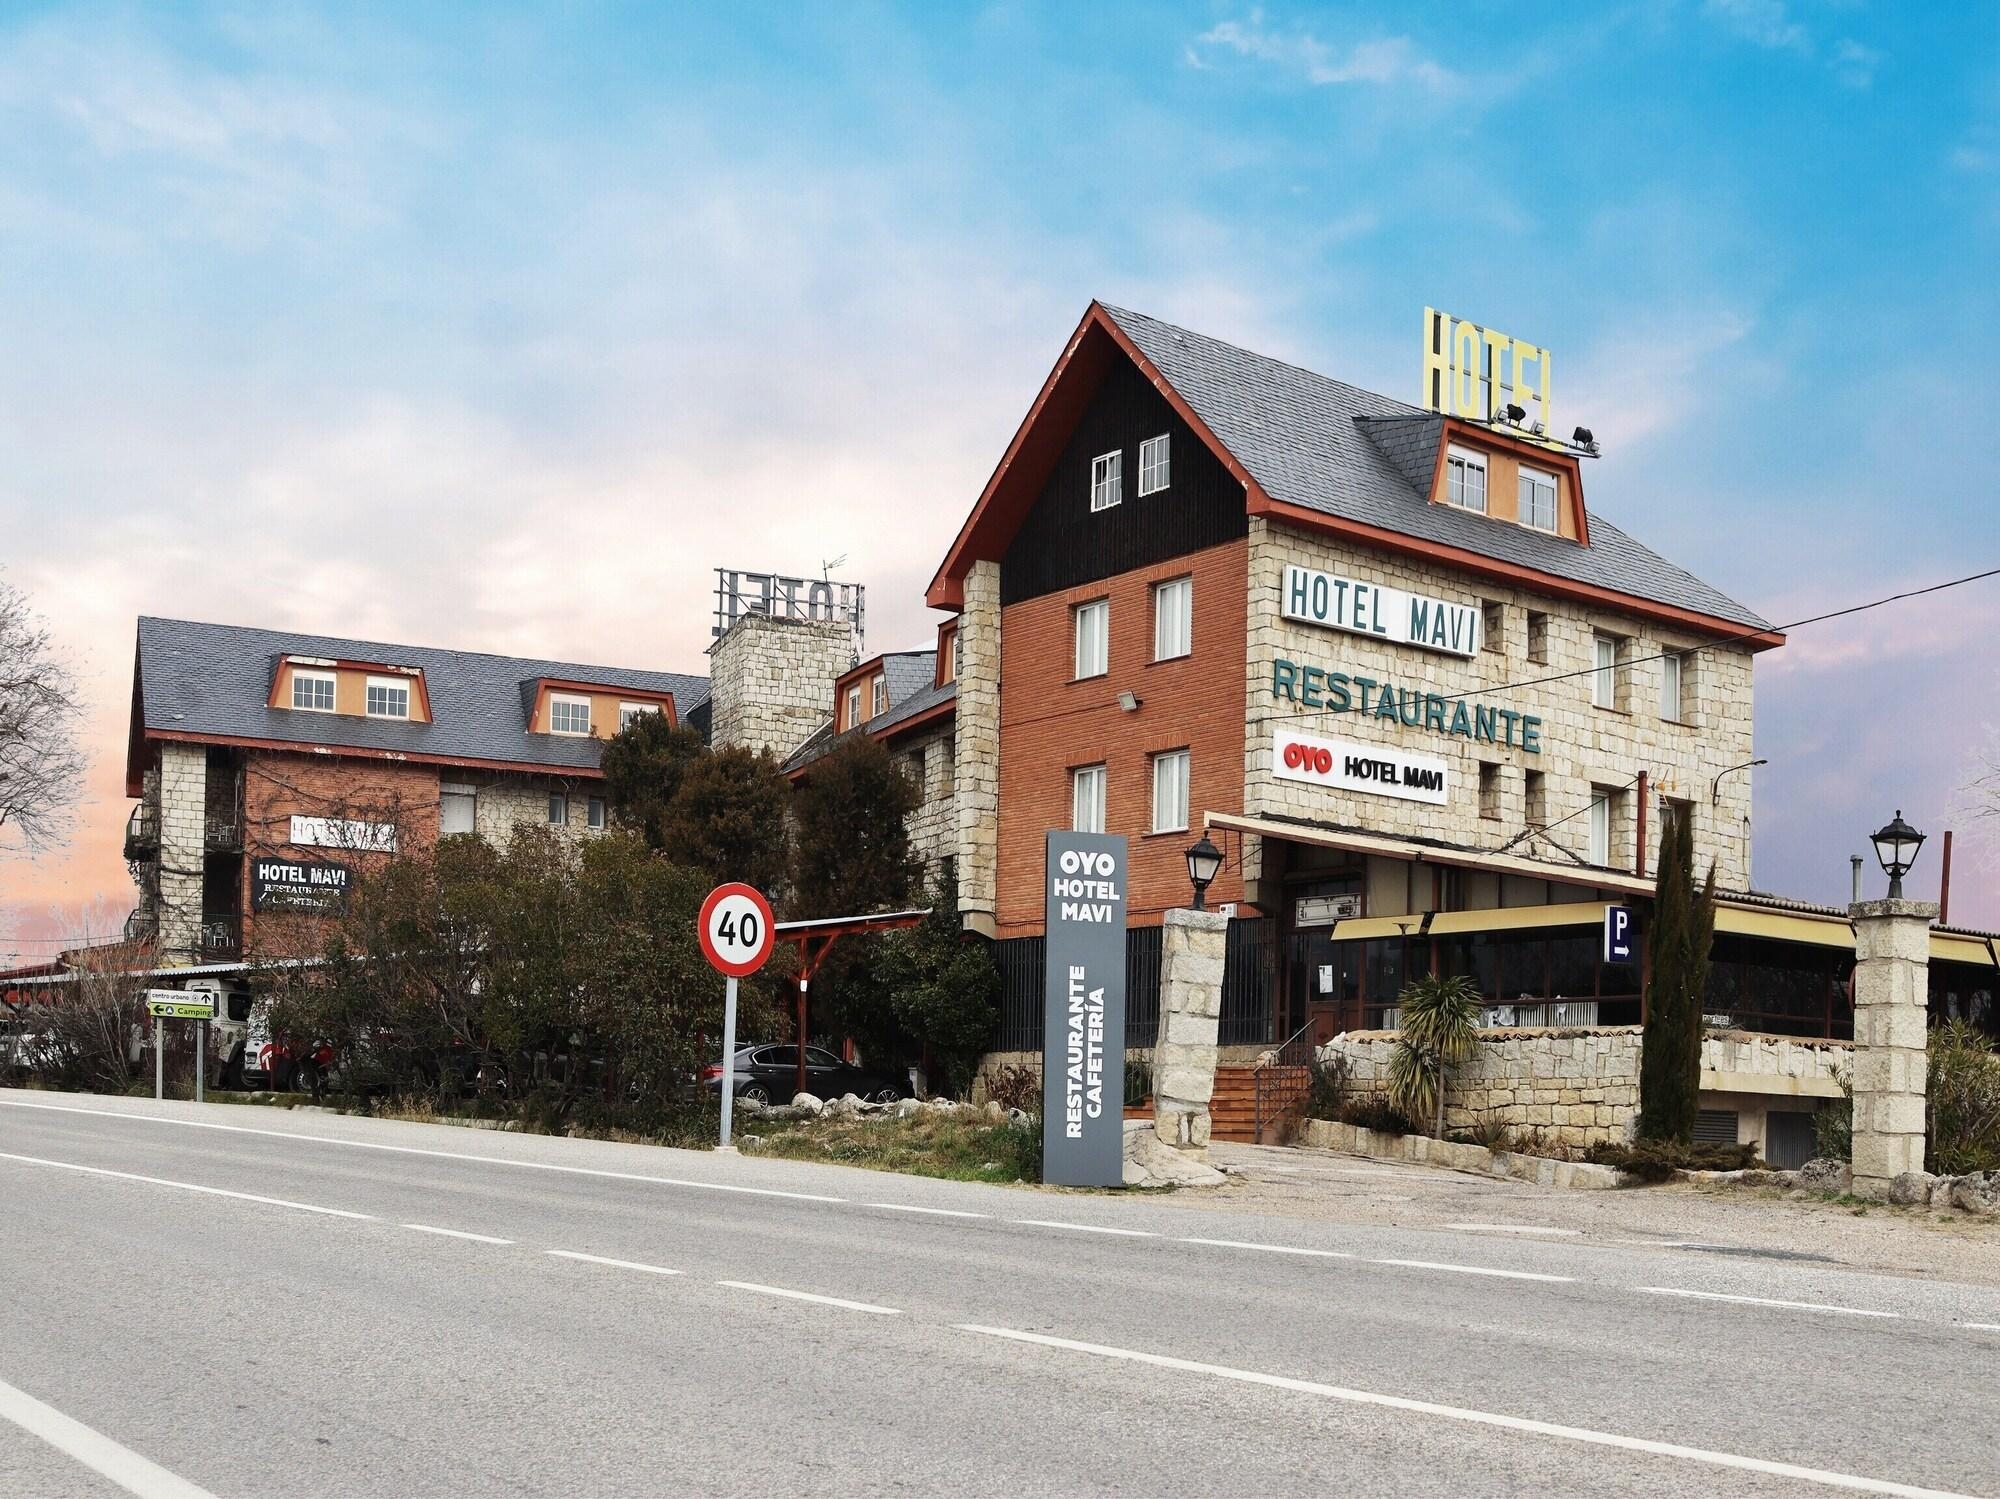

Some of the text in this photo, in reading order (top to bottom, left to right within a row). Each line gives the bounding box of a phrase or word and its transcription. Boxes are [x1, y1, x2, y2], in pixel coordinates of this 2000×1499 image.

[1290, 569, 1476, 653] HOTEL MAVI
[1273, 658, 1542, 754] RESTAURANTE
[1283, 742, 1443, 792] OYO HOTEL MAVI
[259, 864, 346, 886] HOTEL MAVI
[1060, 850, 1116, 877] OYO
[1053, 878, 1121, 901] HOTEL
[718, 911, 758, 948] 40
[1061, 902, 1113, 924] MAVI
[1616, 910, 1628, 941] P
[177, 1007, 212, 1017] Camping
[1067, 965, 1086, 1139] RESTAURANTE
[1084, 987, 1105, 1119] CAFETERÍA
